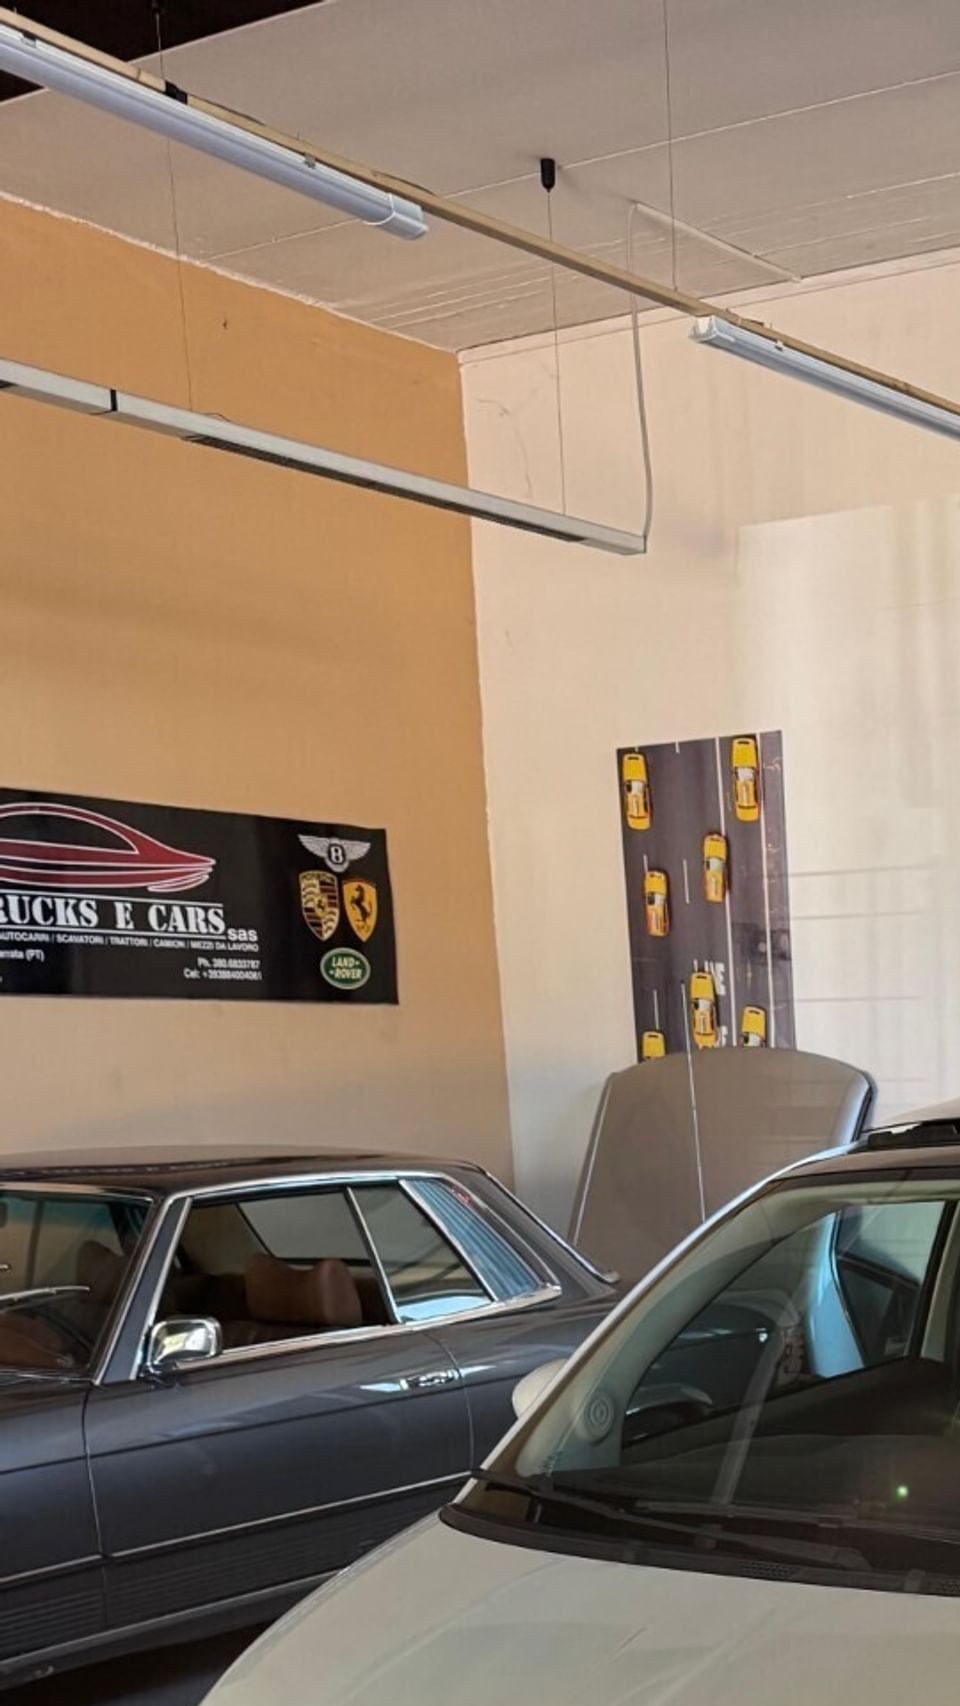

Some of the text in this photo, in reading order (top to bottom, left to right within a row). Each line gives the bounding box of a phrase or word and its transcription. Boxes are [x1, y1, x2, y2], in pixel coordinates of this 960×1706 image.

[114, 901, 135, 930] E
[148, 904, 225, 935] CARS
[227, 928, 258, 942] sas
[331, 956, 356, 968] LAND
[334, 968, 362, 979] ROVER
